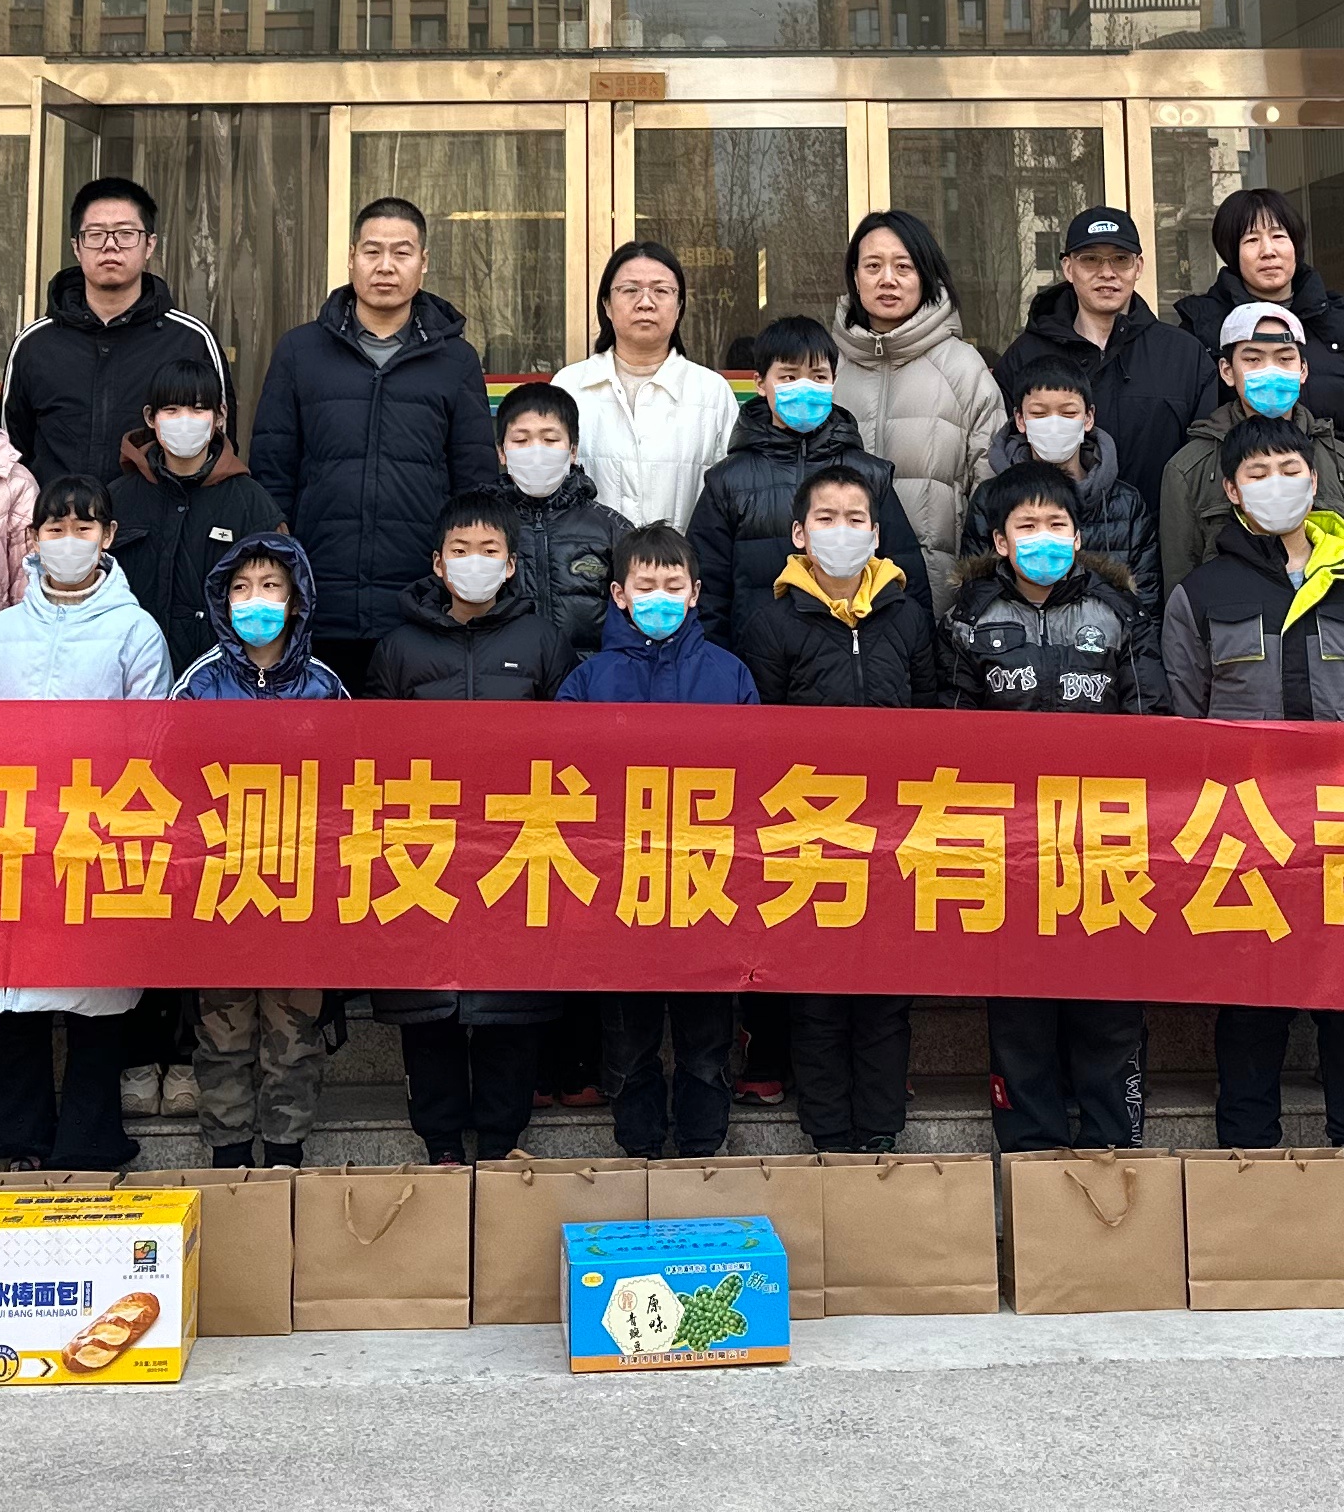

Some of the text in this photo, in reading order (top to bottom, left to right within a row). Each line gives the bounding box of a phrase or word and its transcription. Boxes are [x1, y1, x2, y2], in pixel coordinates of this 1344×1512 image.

[1059, 672, 1112, 703] BOY
[8, 1308, 33, 1318] BANG
[35, 1308, 78, 1318] MIANBAO
